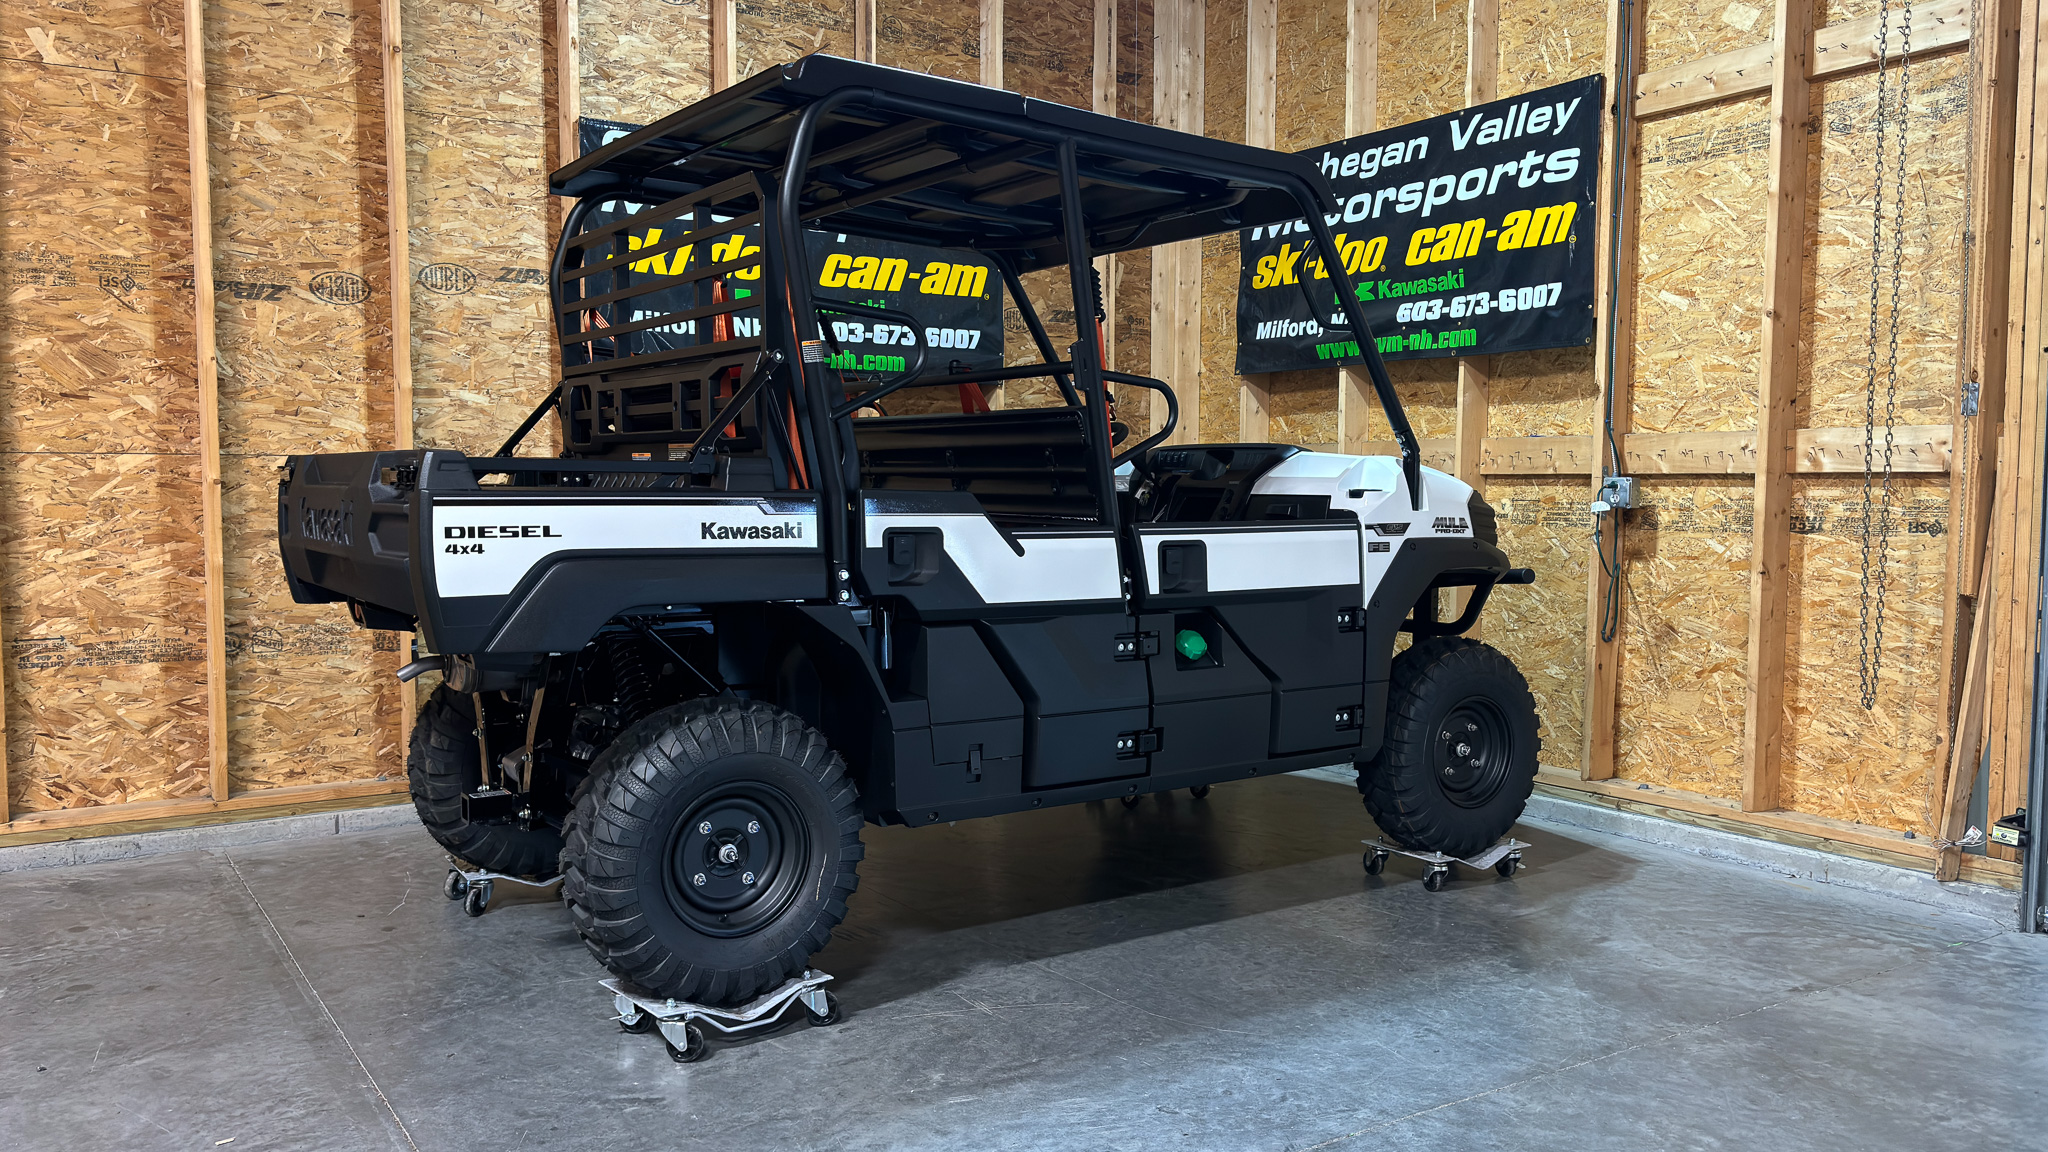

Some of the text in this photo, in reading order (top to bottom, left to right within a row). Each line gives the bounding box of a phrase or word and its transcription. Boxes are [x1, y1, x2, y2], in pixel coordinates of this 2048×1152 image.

[1315, 97, 1581, 180] hegan Valley
[1405, 201, 1577, 266] can-am
[420, 266, 473, 292] HUBER
[819, 254, 989, 298] can-am
[1378, 268, 1465, 299] Kawasaki
[1256, 318, 1324, 340] Milford,
[1396, 282, 1562, 323] 603-673-6007
[817, 321, 980, 349] 03-6736007
[1316, 328, 1477, 359] wwwvm-nh.com
[444, 525, 563, 539] DIESEL
[701, 521, 802, 540] Kawasaki
[444, 543, 485, 555] 4x4
[1368, 542, 1390, 552] FE
